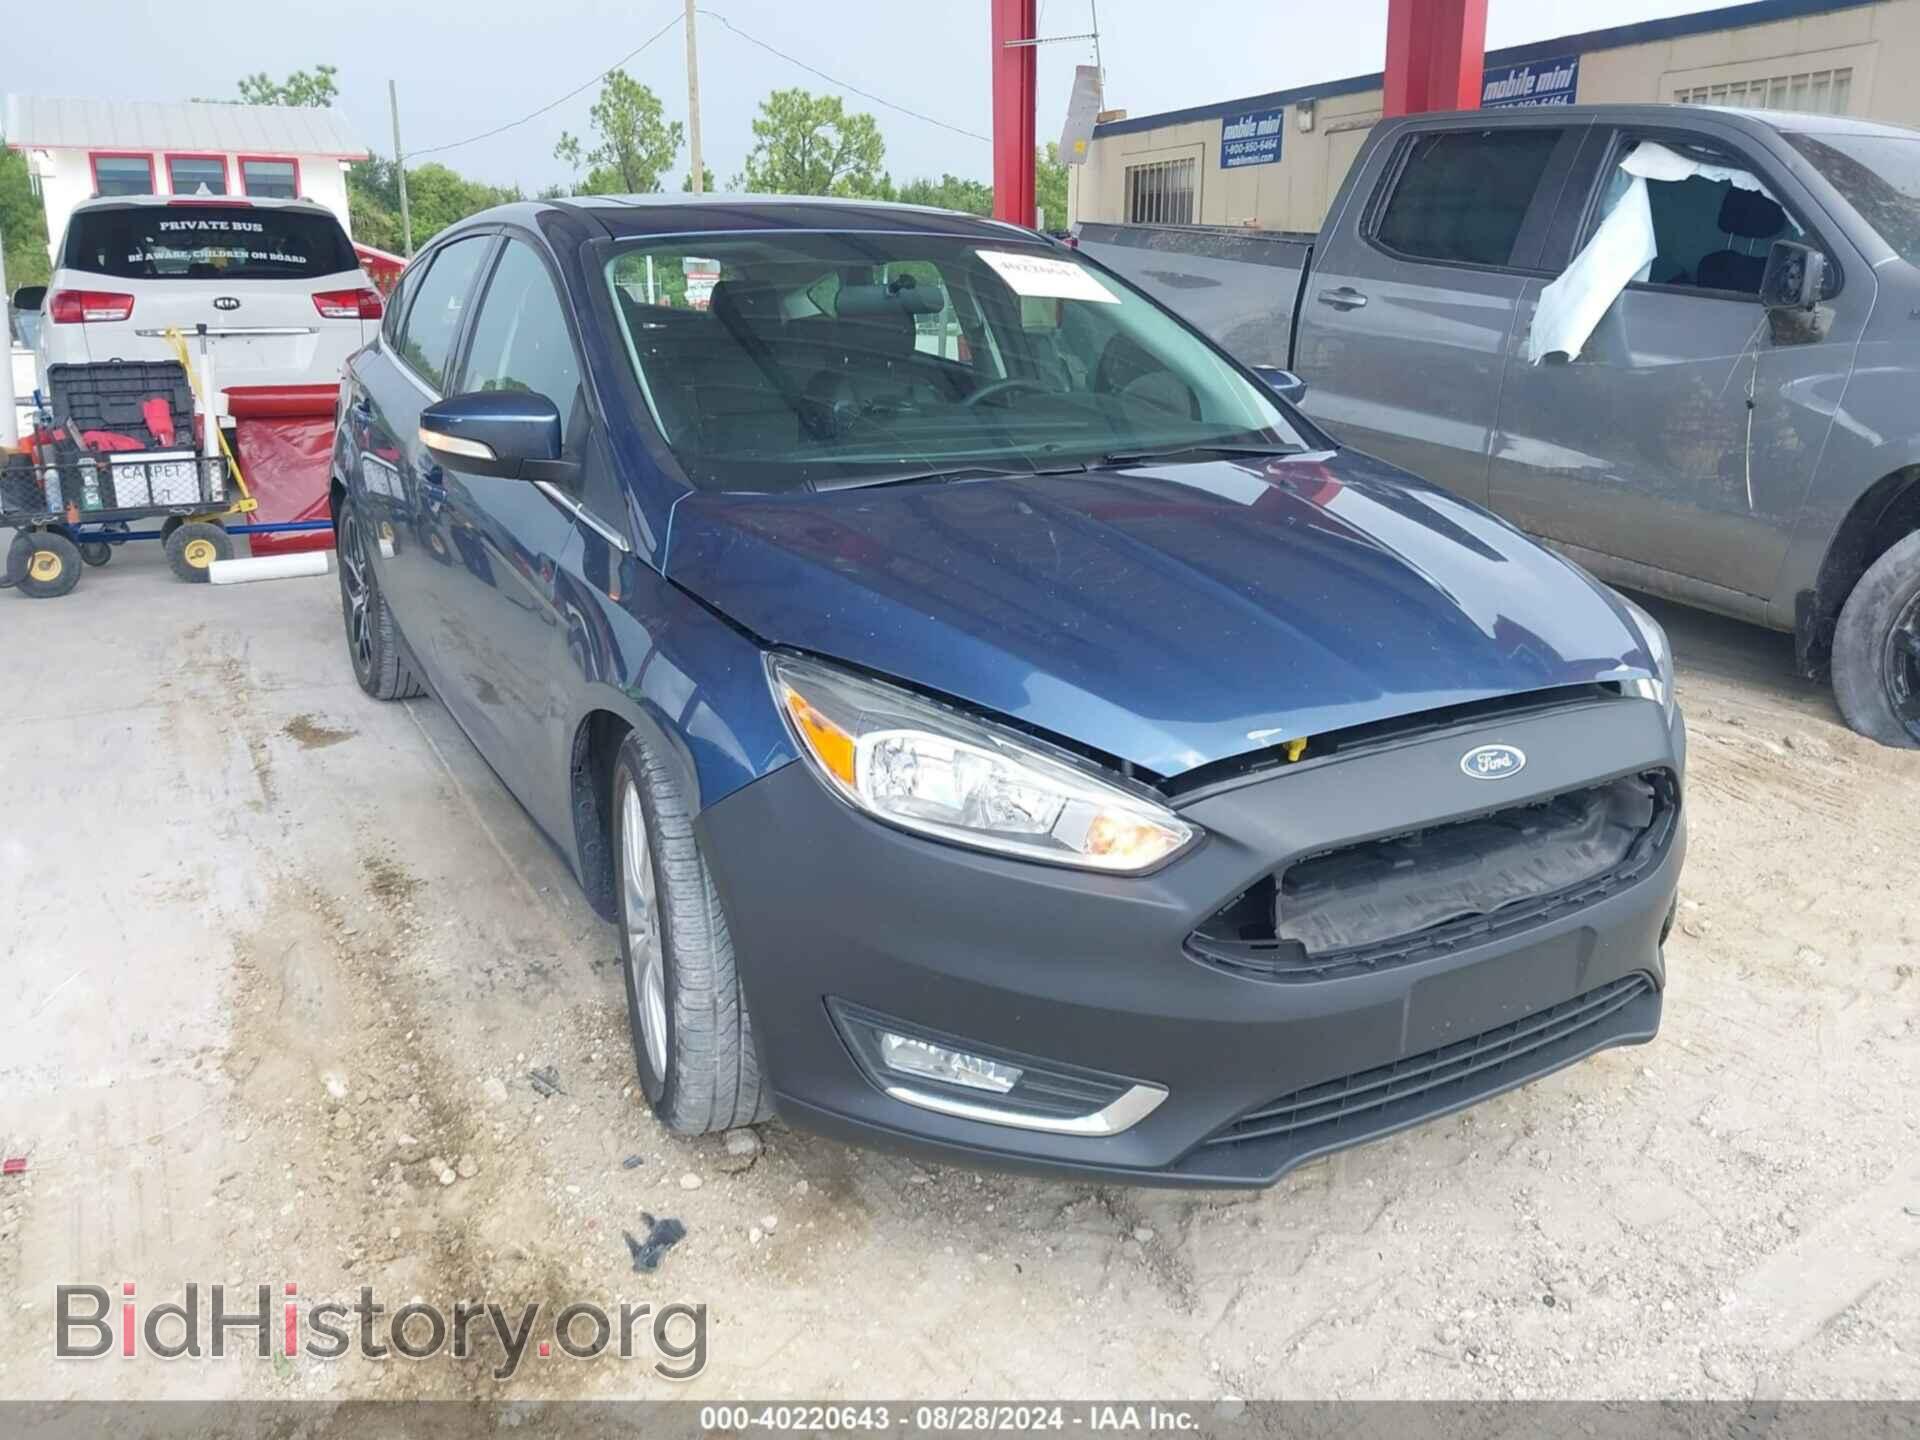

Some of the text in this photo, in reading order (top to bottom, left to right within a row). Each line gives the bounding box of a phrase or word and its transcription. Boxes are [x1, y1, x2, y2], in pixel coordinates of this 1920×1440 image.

[1483, 62, 1577, 100] mobile mini
[1224, 113, 1281, 140] mobile mini
[160, 221, 263, 232] PRIVATE BUS
[128, 249, 307, 264] BE AWARE, CHILDREN ON BOARD
[216, 298, 238, 309] KIA
[1477, 751, 1513, 773] Ford
